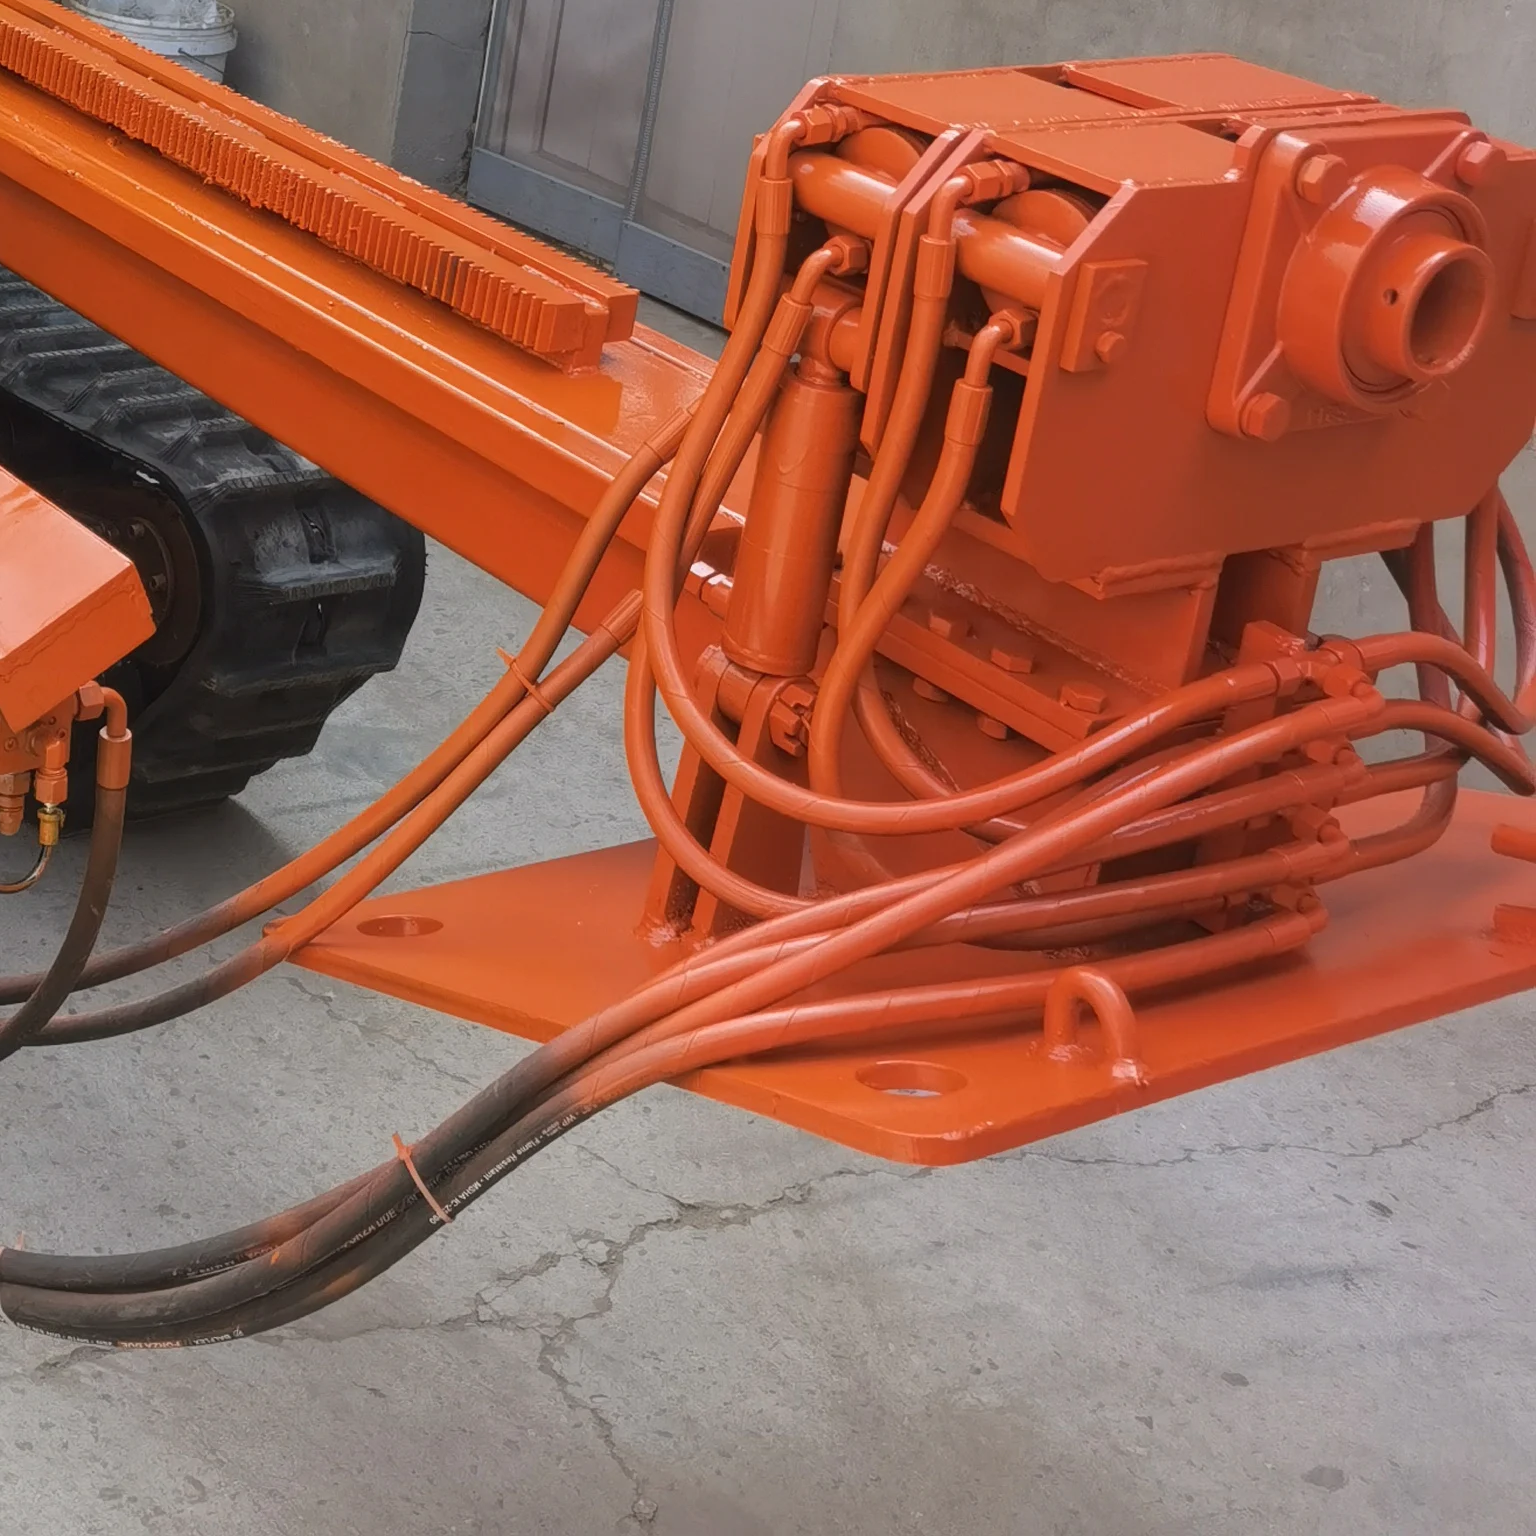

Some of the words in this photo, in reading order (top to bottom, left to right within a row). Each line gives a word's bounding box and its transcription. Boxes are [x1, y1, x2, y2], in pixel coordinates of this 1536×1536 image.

[516, 1137, 540, 1155] Flame
[485, 1154, 518, 1181] Resistant
[458, 1181, 482, 1201] MSHA
